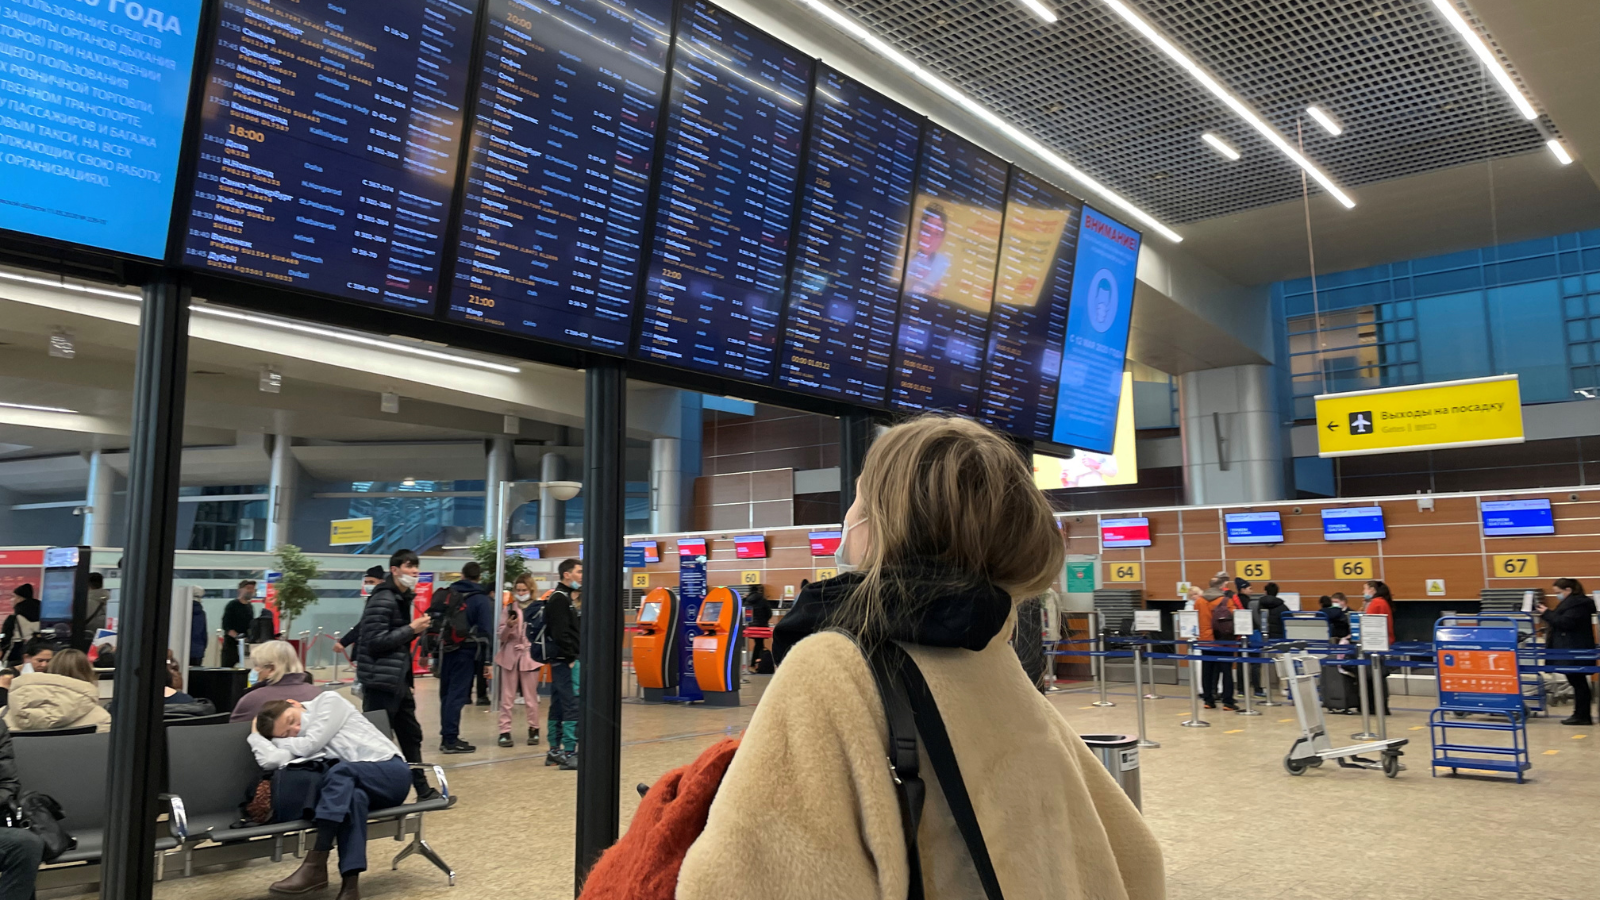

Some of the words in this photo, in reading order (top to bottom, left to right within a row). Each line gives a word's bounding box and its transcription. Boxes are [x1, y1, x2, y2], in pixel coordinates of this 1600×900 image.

[108, 0, 182, 36] ГОДА
[507, 13, 532, 30] 20:00
[60, 24, 116, 51] ОРГАНОВ
[47, 38, 74, 56] ПРИ
[10, 62, 88, 95] РОЗНИЧНОЙ
[8, 98, 96, 132] ПАССАЖИРОВ
[97, 123, 107, 135] И
[109, 126, 156, 148] БАГАЖА
[228, 123, 264, 144] 18:00
[81, 136, 99, 150] НА
[101, 140, 132, 159] ВСЕХ
[77, 153, 114, 172] СВОЮ
[1085, 215, 1137, 251] ВНИМАНИЕ!
[662, 269, 682, 279] 22:00
[468, 293, 495, 308] 21:00
[1381, 409, 1432, 420] Выходы
[1434, 407, 1448, 415] на
[1451, 402, 1504, 413] посадку
[1117, 567, 1133, 578] 64
[1244, 564, 1263, 576] 65
[1343, 563, 1363, 574] 66
[1505, 559, 1527, 572] 67
[637, 577, 646, 585] 58
[746, 574, 756, 583] 60
